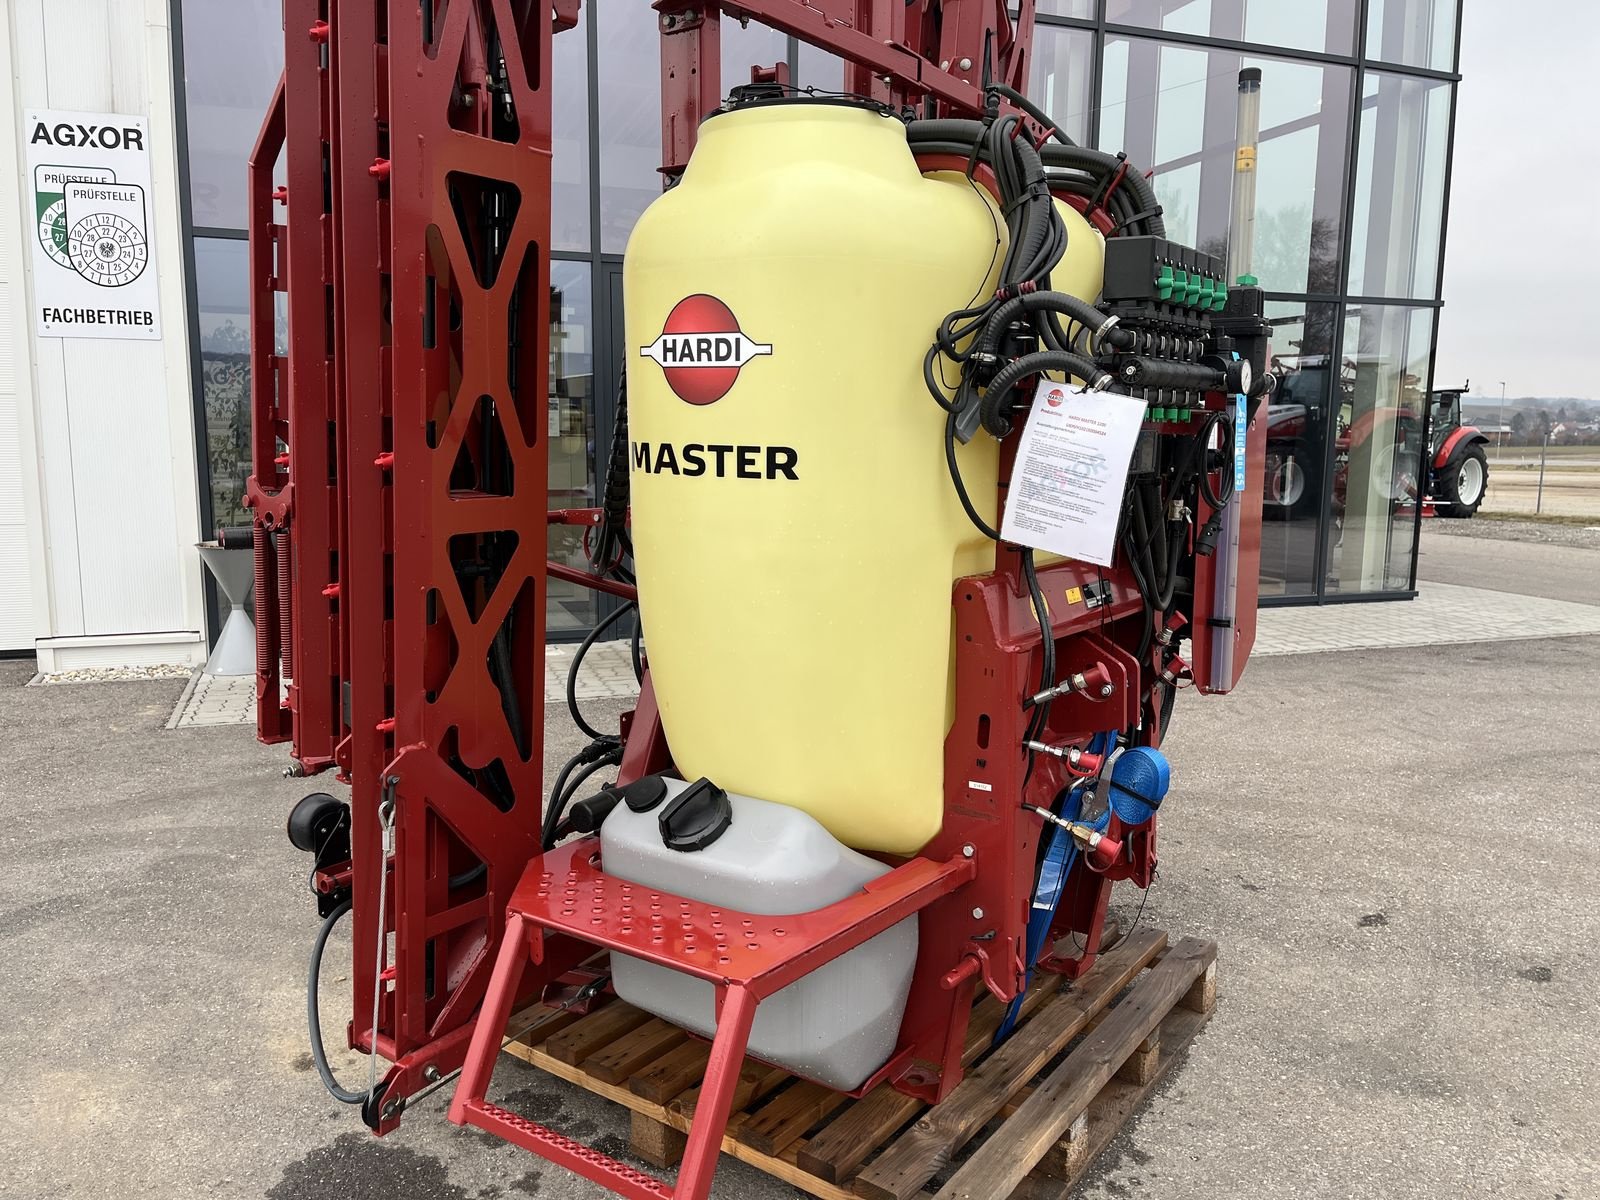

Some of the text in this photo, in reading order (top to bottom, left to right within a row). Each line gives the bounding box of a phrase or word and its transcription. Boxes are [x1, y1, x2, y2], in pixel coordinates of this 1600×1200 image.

[31, 122, 144, 151] AGXOR
[73, 189, 136, 202] PRÜFSTELLE
[45, 214, 53, 222] 10
[102, 216, 110, 224] 12
[85, 219, 93, 227] 11
[44, 229, 48, 237] 9
[74, 230, 82, 238] 10
[102, 228, 110, 236] 22
[133, 232, 138, 240] 2
[55, 233, 64, 242] 27
[87, 234, 95, 242] 28
[118, 235, 127, 243] 23
[84, 250, 93, 258] 27
[122, 250, 131, 258] 24
[138, 248, 143, 256] 3
[78, 260, 82, 268] 8
[96, 262, 105, 270] 26
[113, 263, 122, 271] 25
[134, 262, 139, 270] 4
[107, 277, 112, 285] 6
[124, 273, 129, 281] 5
[42, 307, 154, 326] FACHBETRIEB
[662, 337, 741, 363] HARDI
[631, 441, 799, 481] MASTER
